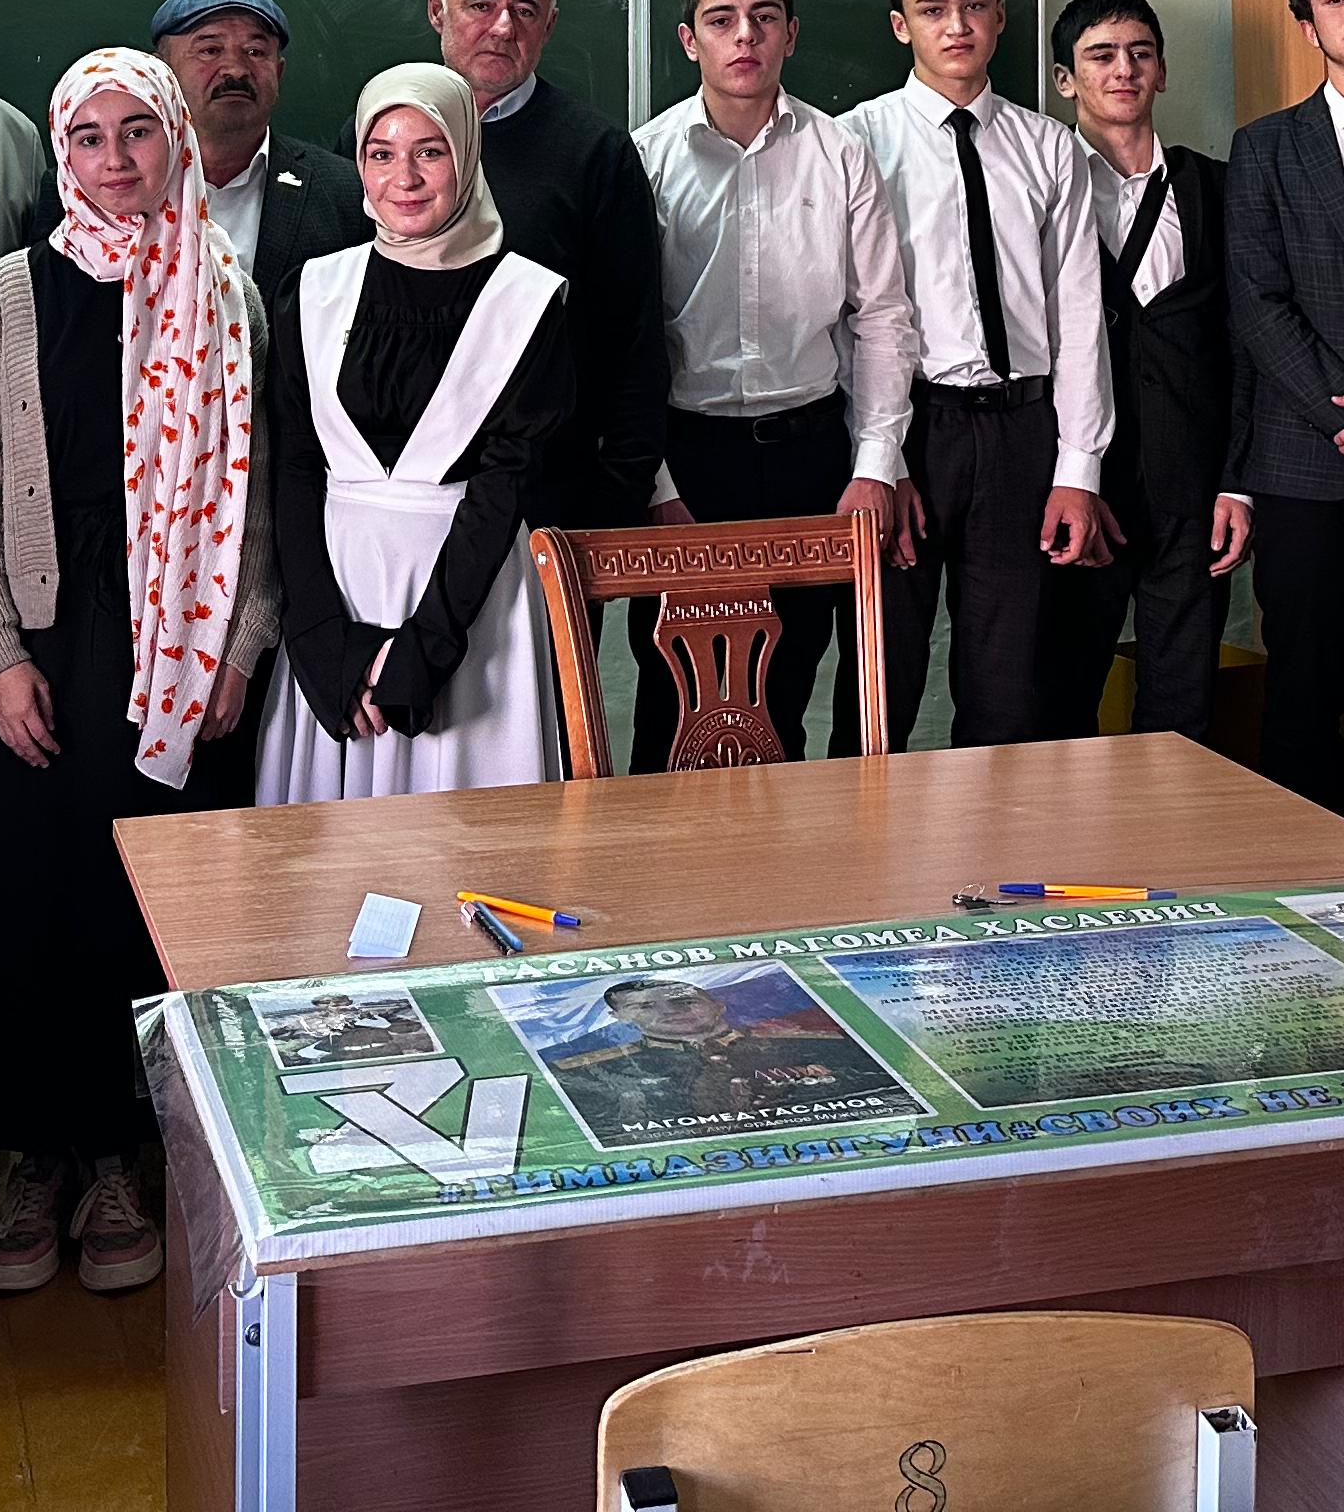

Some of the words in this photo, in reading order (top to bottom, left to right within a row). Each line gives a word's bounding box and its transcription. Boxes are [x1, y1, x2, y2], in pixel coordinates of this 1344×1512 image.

[482, 947, 716, 983] ГАСАНОВ
[735, 925, 969, 963] МАГОМЕД
[974, 898, 1229, 936] ХАСАЕВИЧ
[621, 1111, 755, 1133] МАГОМЕД
[758, 1096, 884, 1119] ГАСАНОВ
[1253, 1085, 1342, 1114] НЕ
[894, 1439, 948, 1512] 8
